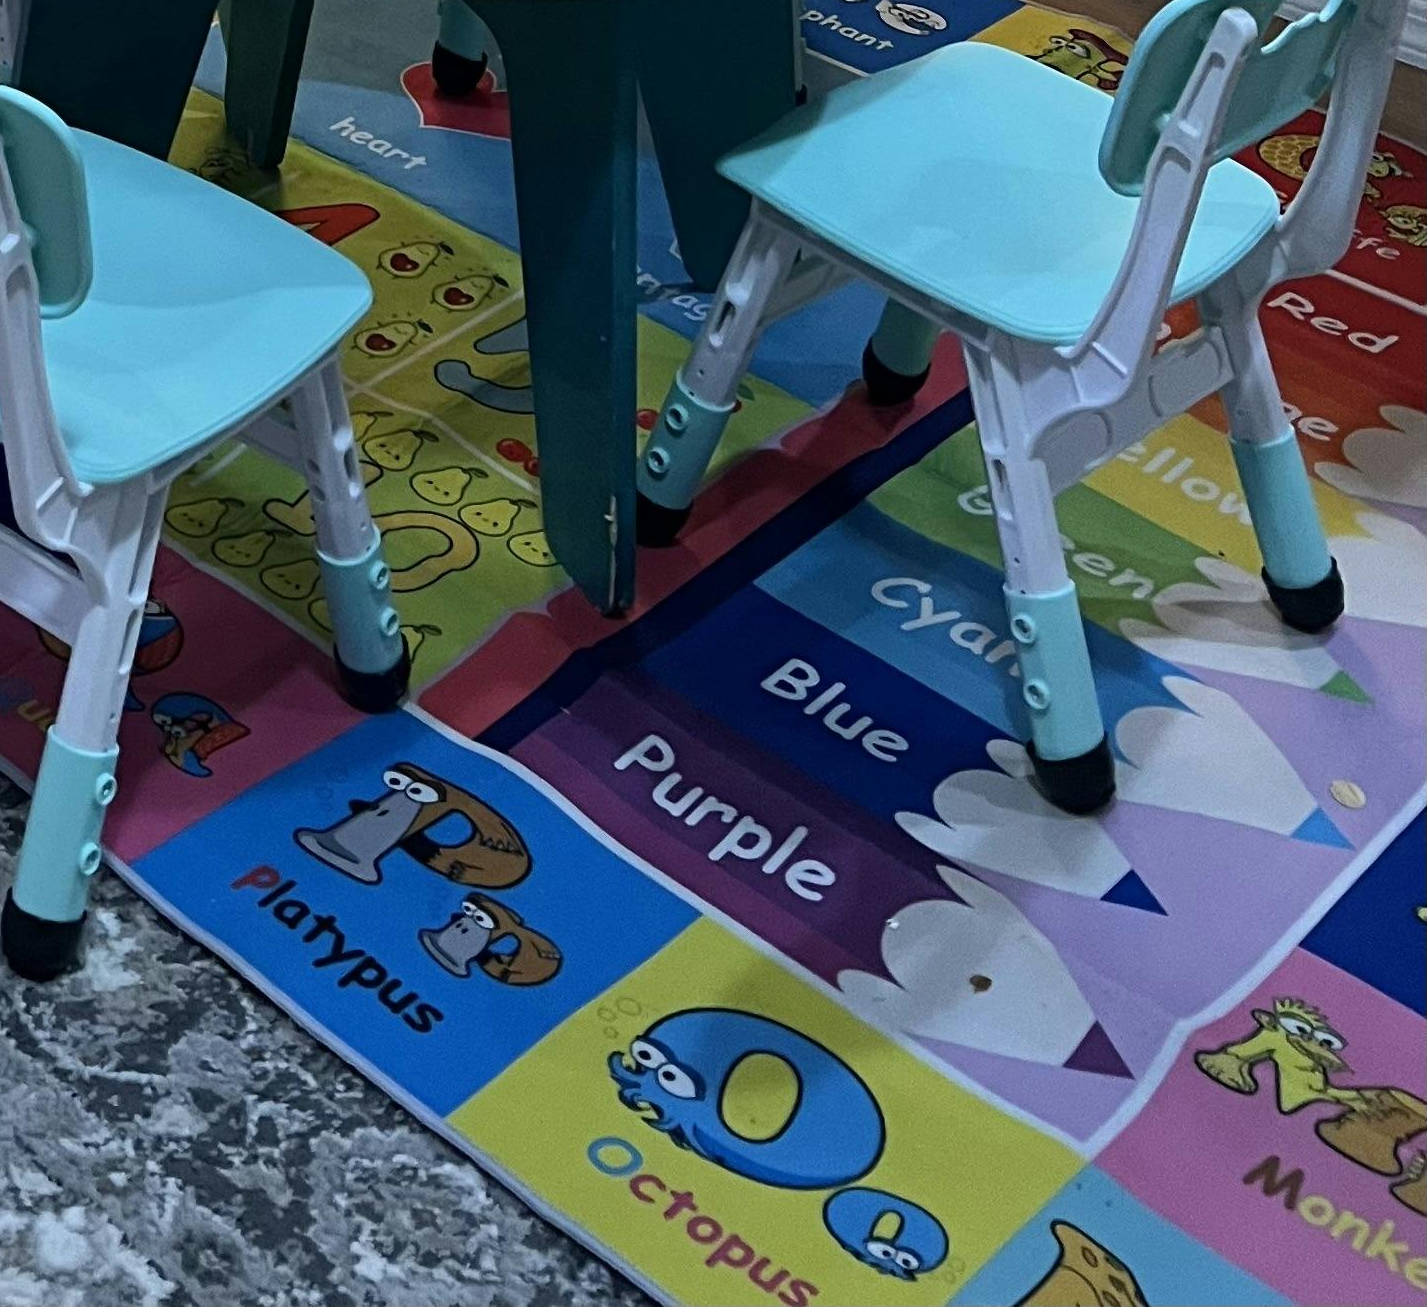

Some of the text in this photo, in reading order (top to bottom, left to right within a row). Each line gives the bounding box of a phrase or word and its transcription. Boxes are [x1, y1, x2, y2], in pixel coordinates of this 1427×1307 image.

[800, 10, 894, 50] phant
[328, 115, 427, 173] heart
[1267, 291, 1400, 354] Red
[956, 483, 1155, 600] Gen
[759, 657, 910, 763] Blue
[613, 732, 837, 903] Purple
[233, 865, 446, 1036] Platypus
[586, 1135, 821, 1307] Octopus
[1243, 1154, 1427, 1291] Monke
